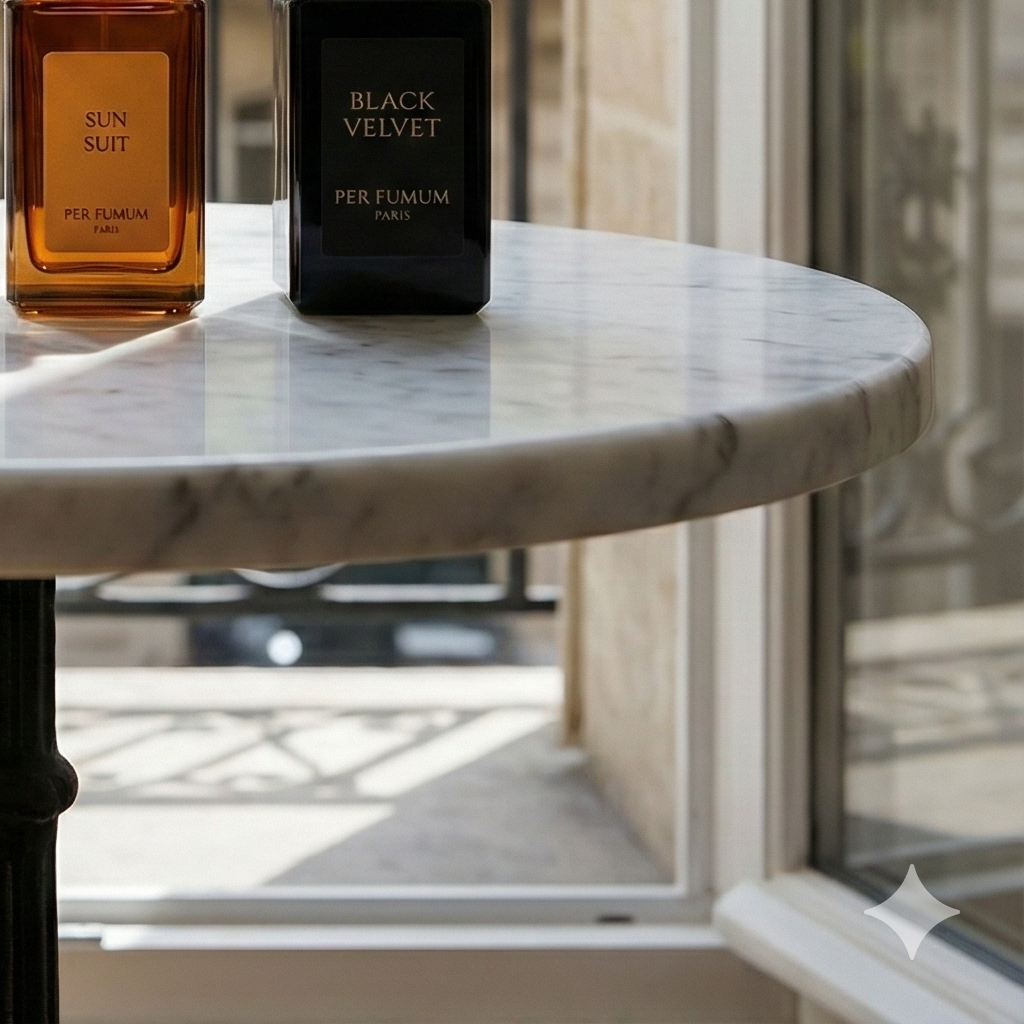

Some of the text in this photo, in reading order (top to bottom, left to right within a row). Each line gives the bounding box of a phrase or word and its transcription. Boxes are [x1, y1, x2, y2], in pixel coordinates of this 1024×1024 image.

[350, 91, 435, 111] BLACK
[85, 111, 127, 128] SUN
[343, 117, 441, 137] VELVET
[83, 136, 130, 152] SUIT
[334, 189, 450, 205] PER FUMUM
[64, 208, 149, 220] PER FUMUM
[375, 210, 411, 221] PARIS
